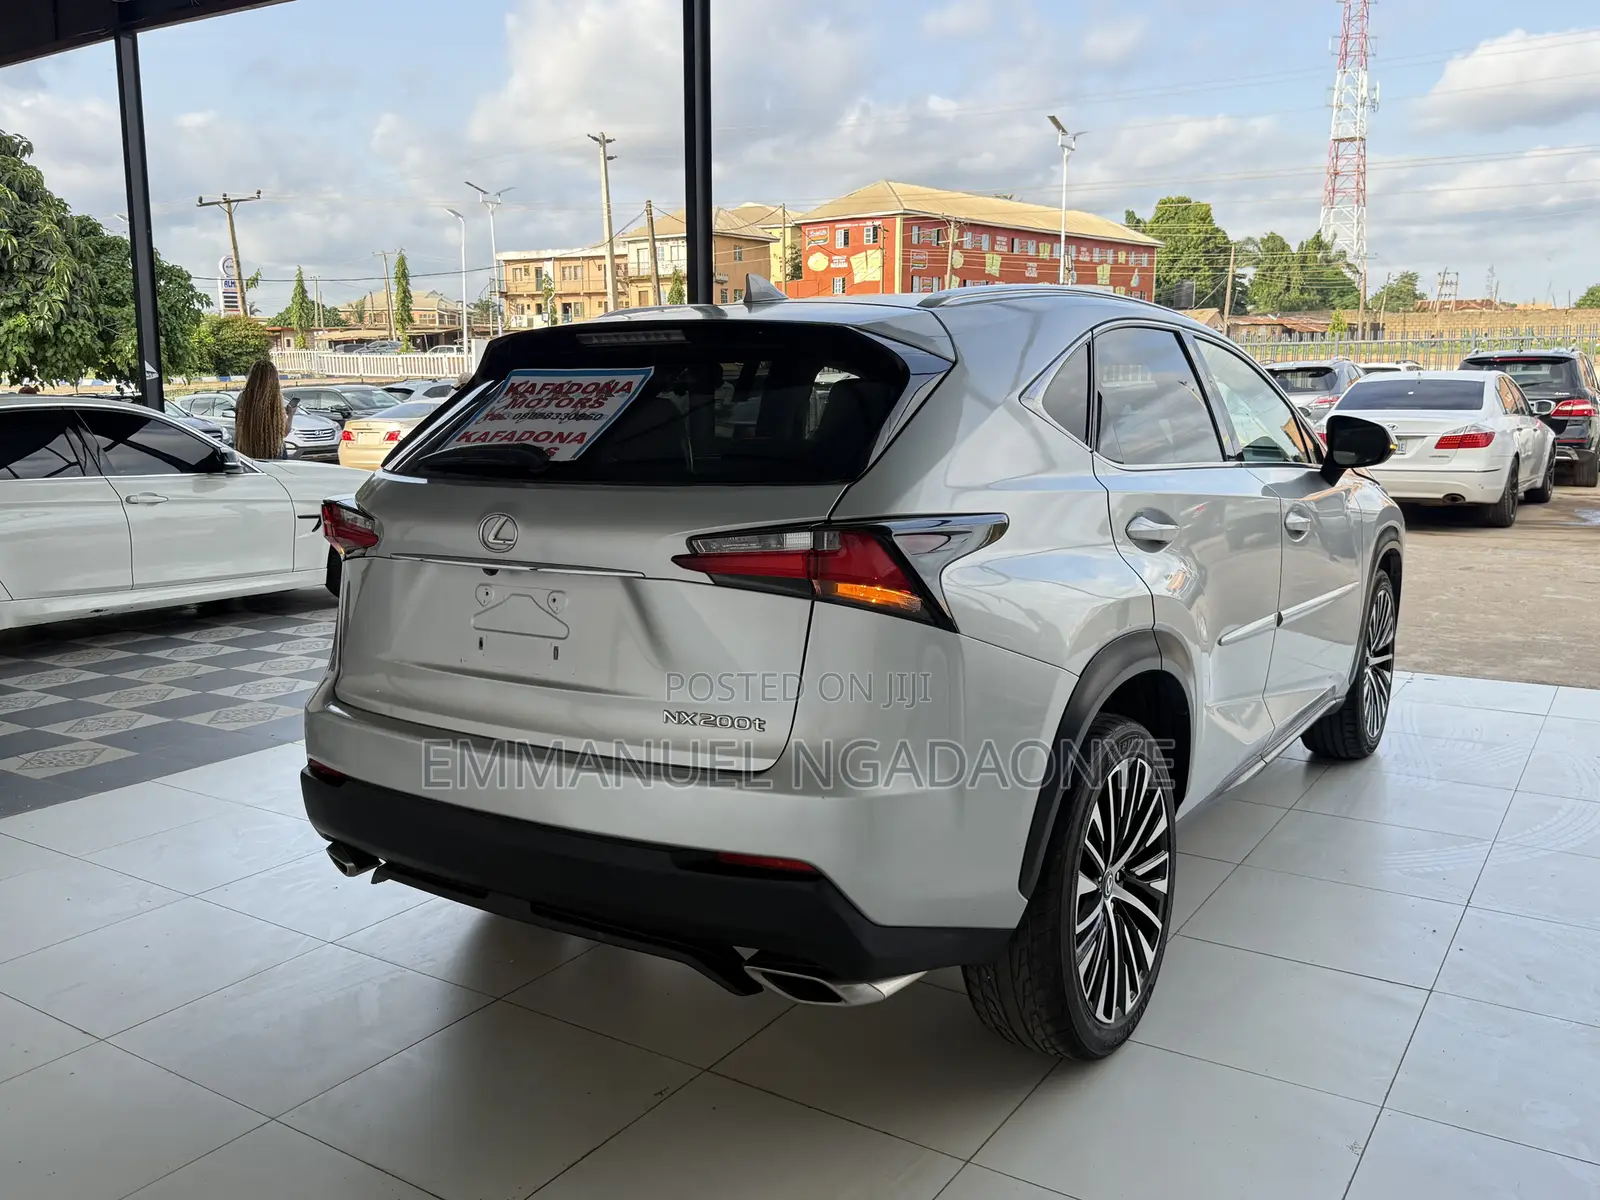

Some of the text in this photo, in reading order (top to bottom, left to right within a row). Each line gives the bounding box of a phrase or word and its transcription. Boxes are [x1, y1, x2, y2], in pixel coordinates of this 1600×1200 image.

[505, 382, 634, 396] KAFADONA
[508, 397, 606, 409] MOTORS
[455, 430, 588, 445] KAFADONA
